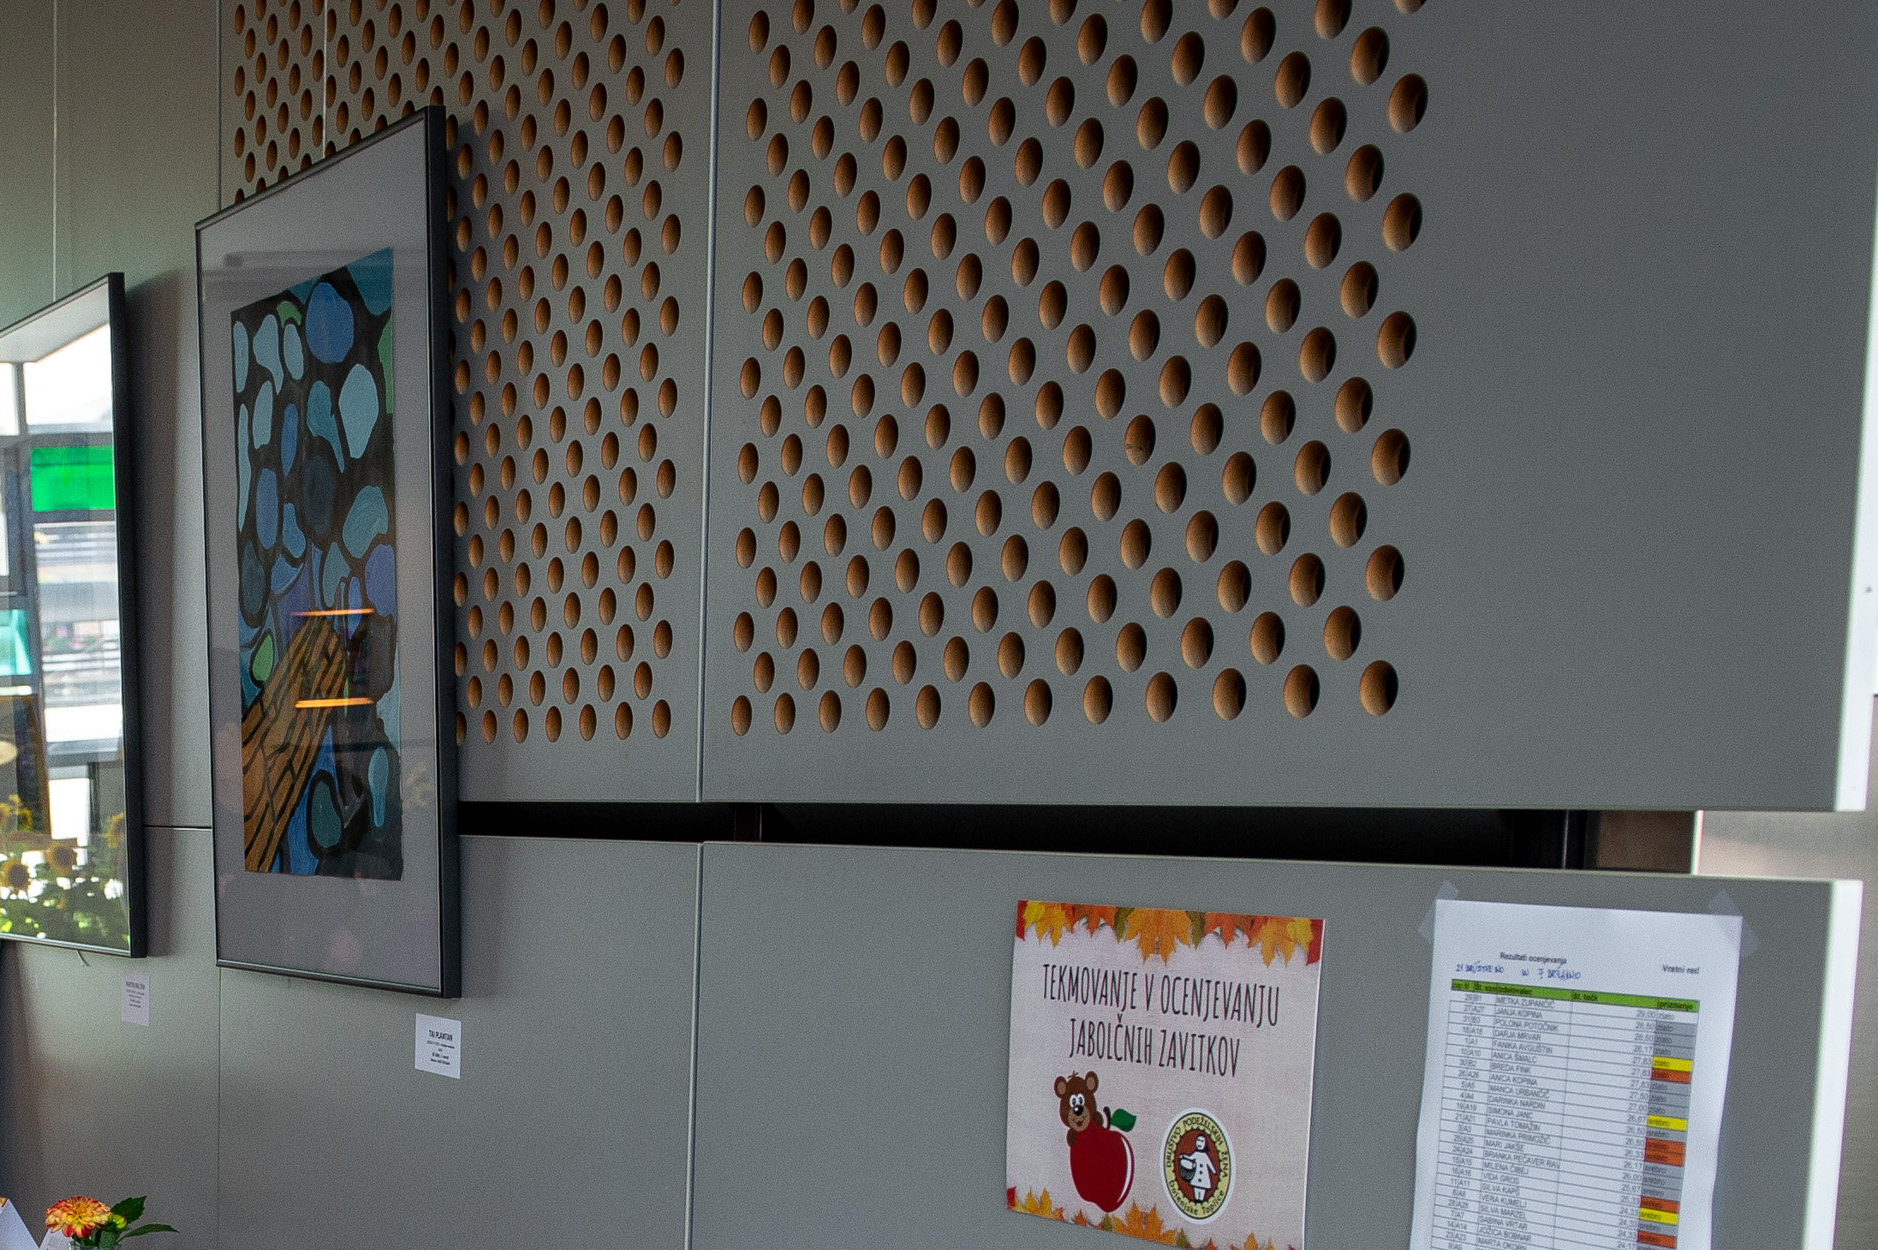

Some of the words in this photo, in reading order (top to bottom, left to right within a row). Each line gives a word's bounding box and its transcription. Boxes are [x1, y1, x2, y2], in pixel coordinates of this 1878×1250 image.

[1500, 952, 1527, 960] Rezultati
[1528, 955, 1566, 965] ocenjevanja
[1661, 964, 1685, 973] Vrstni
[1687, 966, 1699, 974] red
[1042, 963, 1138, 1012] TEKMOVANJE
[1144, 973, 1154, 1012] V
[1160, 975, 1280, 1028] OCENJEVANJU
[1069, 1013, 1153, 1066] JABOLČNIH
[1158, 1029, 1240, 1077] ZAVITKOV
